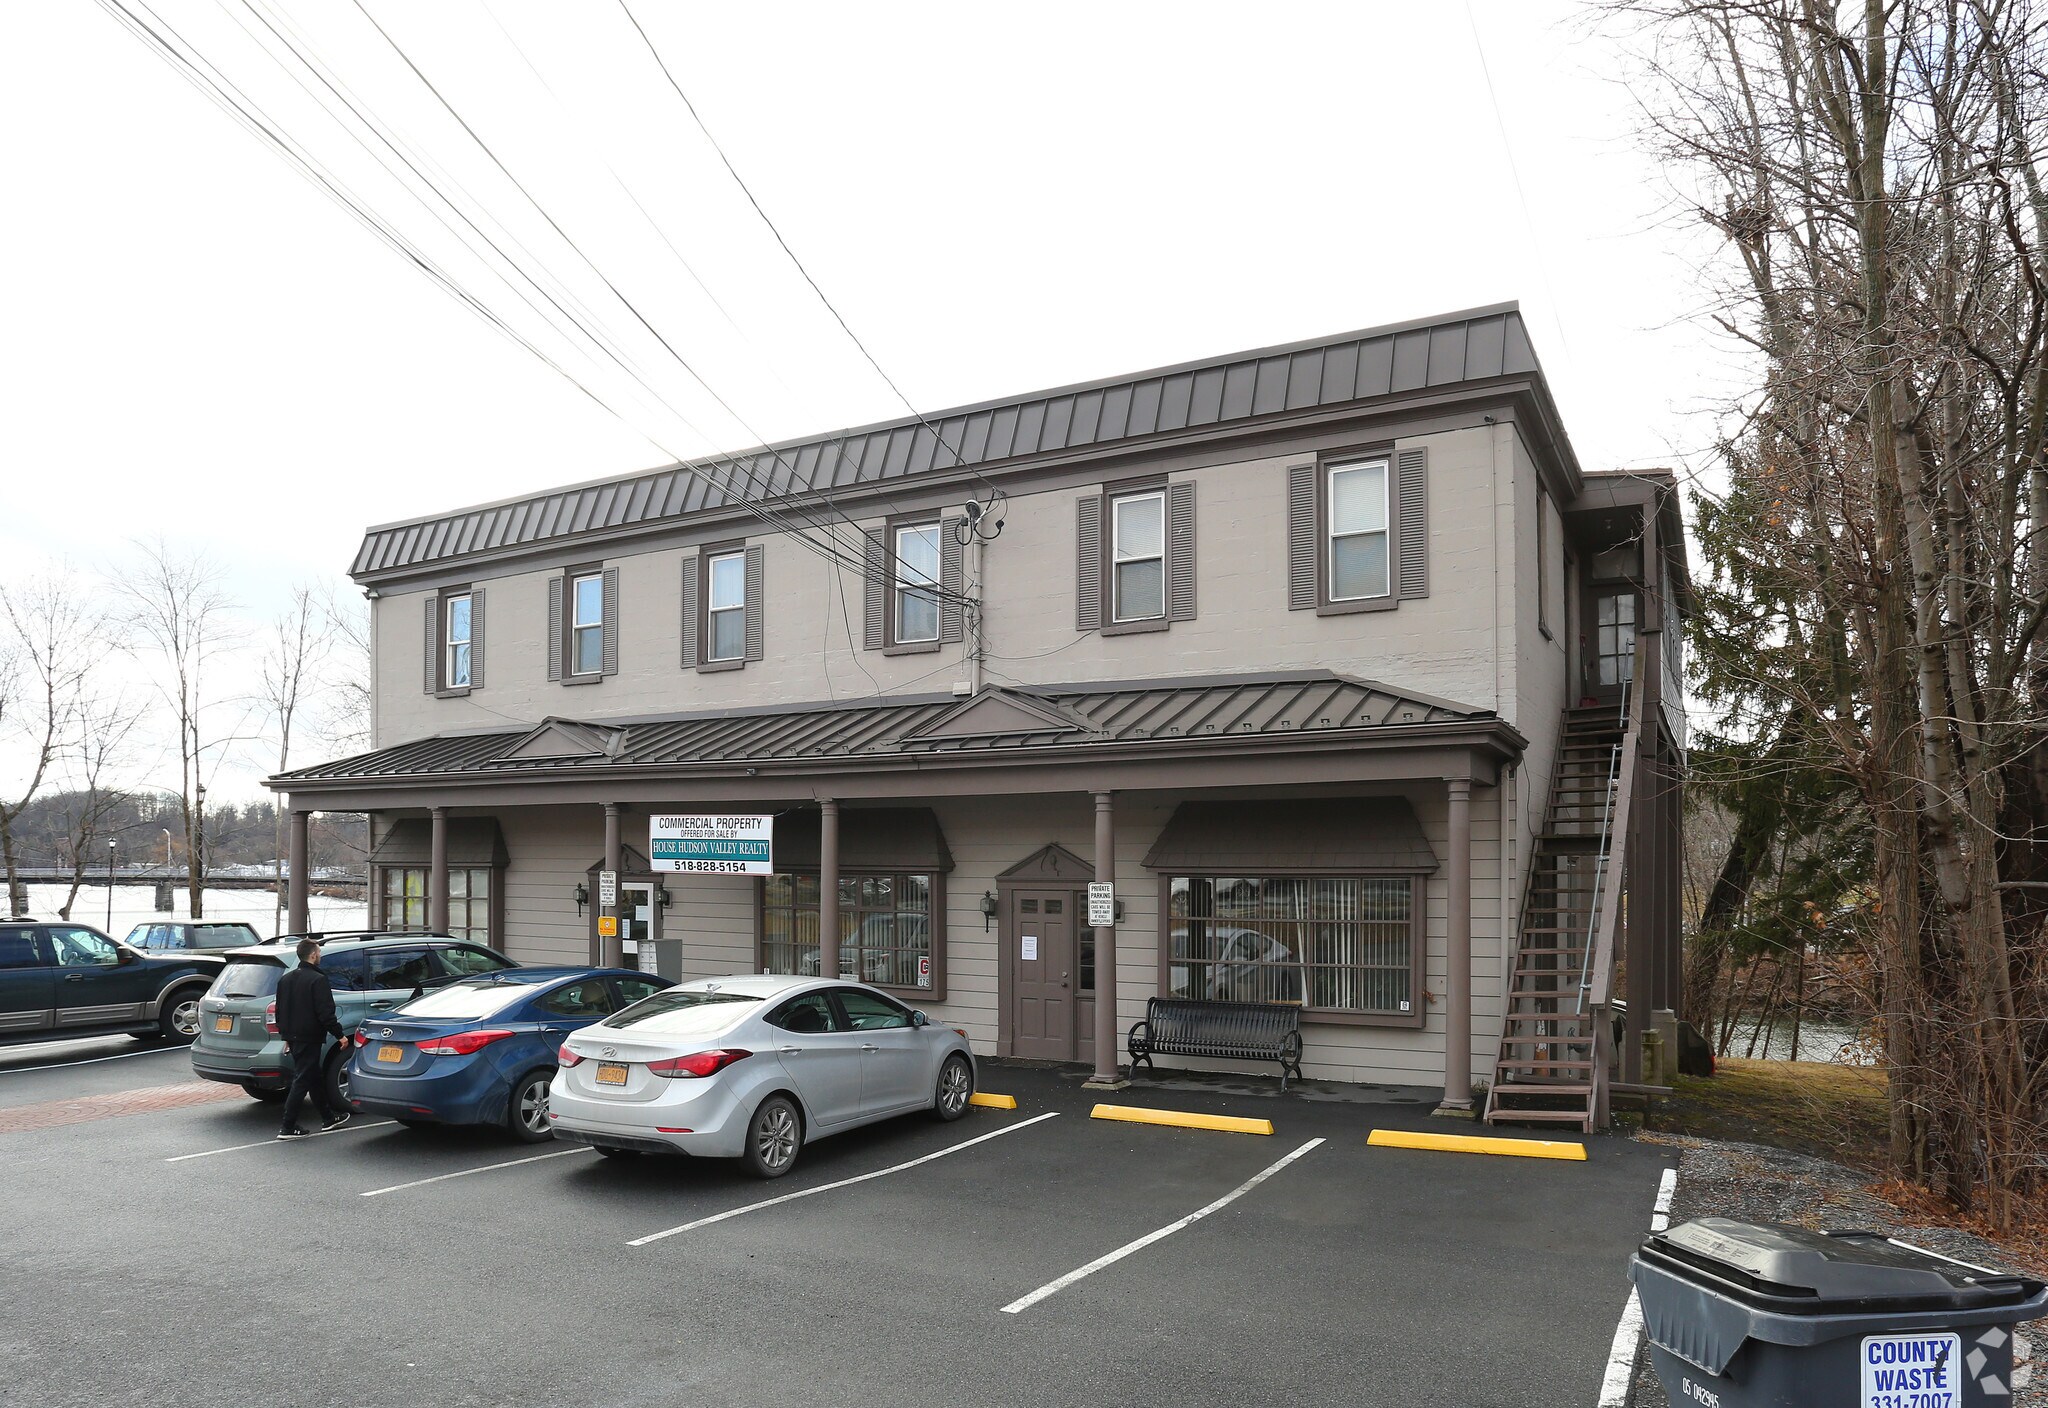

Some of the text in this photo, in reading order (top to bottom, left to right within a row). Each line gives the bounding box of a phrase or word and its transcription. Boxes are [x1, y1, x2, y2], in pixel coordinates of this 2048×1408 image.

[659, 817, 762, 829] COMMERCIAL PROPERTY
[680, 829, 738, 838] OFFERED FOR SALE BY
[653, 841, 768, 855] HOUSE HUDSON VALLEY REALTY
[674, 861, 746, 872] 518-828-5154
[1868, 1339, 1953, 1365] COUNTY
[1874, 1367, 1948, 1392] WASTE
[1870, 1392, 1953, 1408] 331-7007
